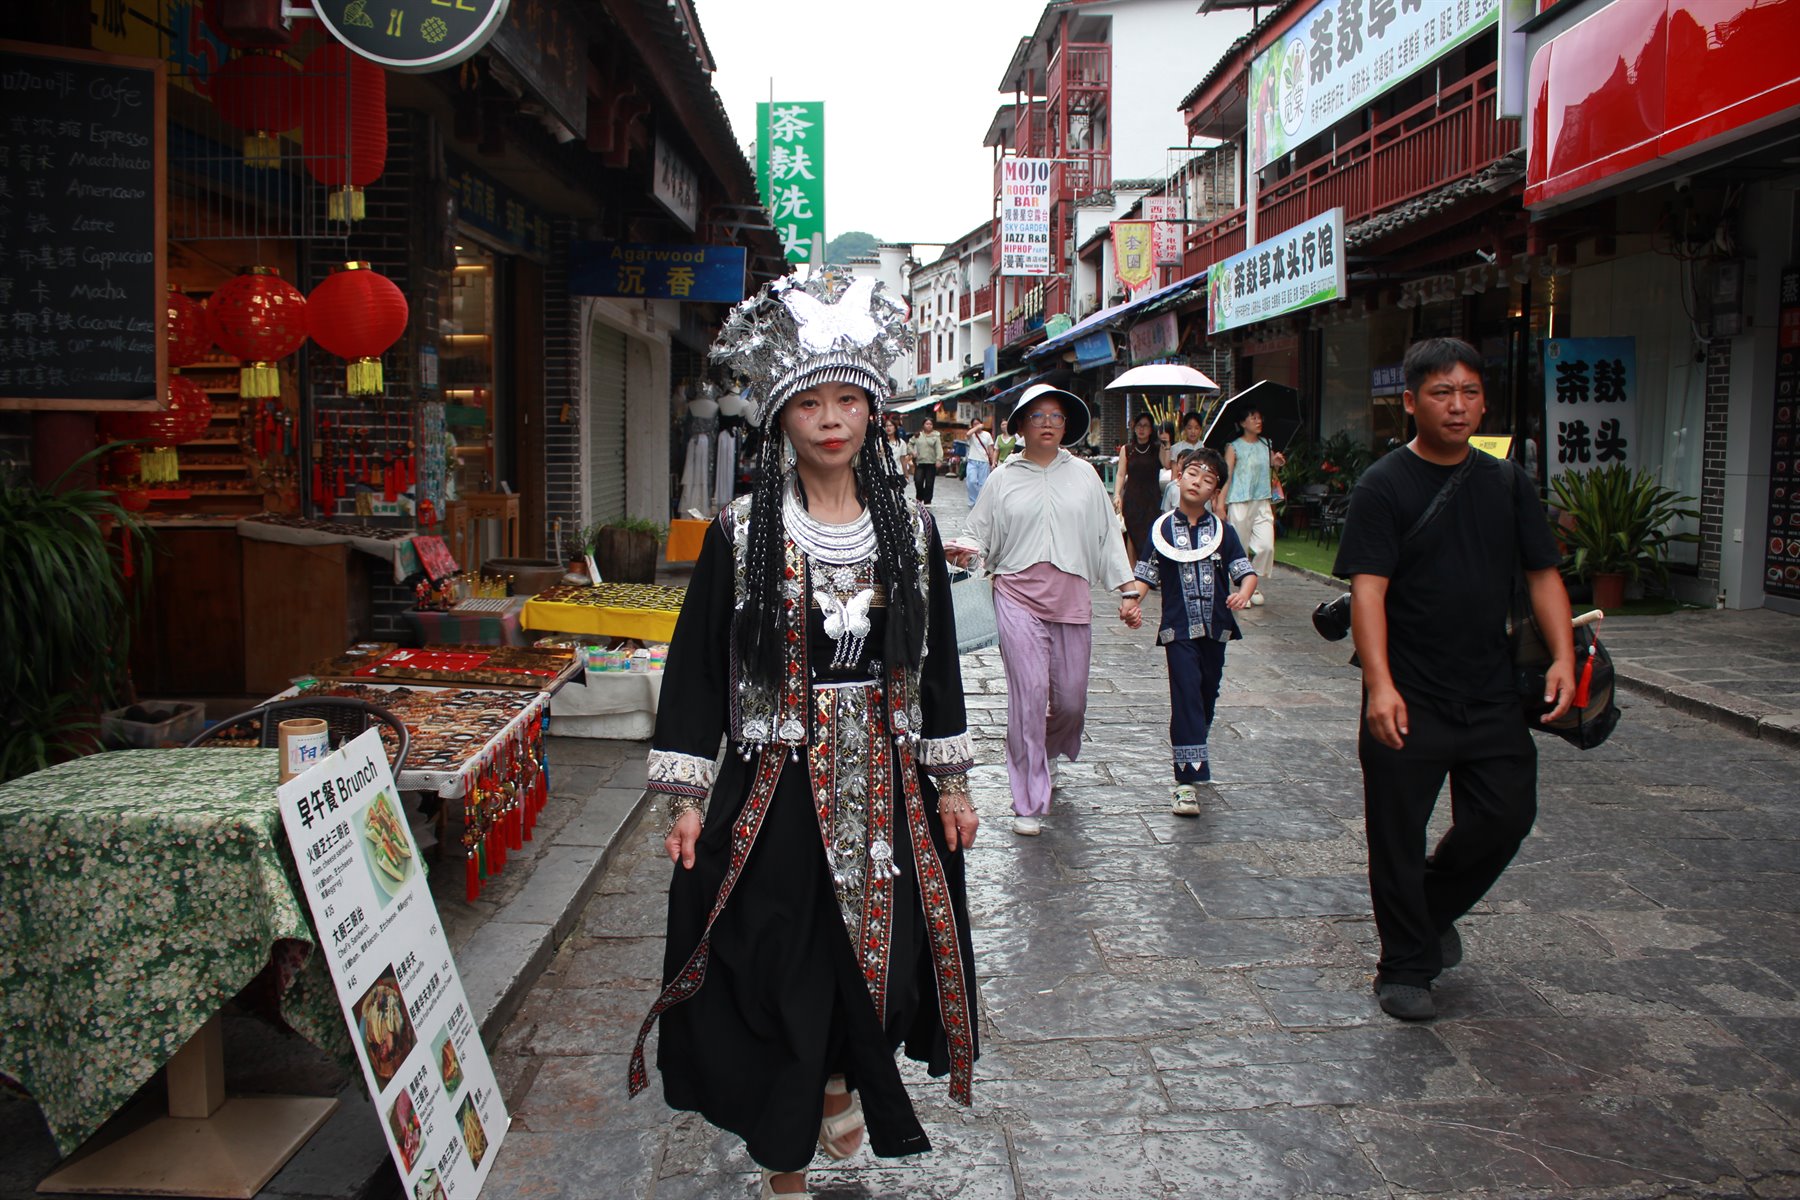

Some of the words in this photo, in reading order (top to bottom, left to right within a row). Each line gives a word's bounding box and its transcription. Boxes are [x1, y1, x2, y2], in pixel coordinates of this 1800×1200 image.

[1310, 0, 1421, 86] 茶麸草
[0, 114, 82, 138] 式浓缩
[90, 122, 148, 149] Espresso
[69, 152, 150, 170] Macchiato
[1005, 161, 1048, 183] MOJO
[66, 177, 145, 198] Americano
[1007, 185, 1047, 195] ROOFTOP
[1014, 197, 1039, 207] BAR
[72, 214, 115, 233] Latte
[1005, 223, 1019, 231] SKY
[1020, 223, 1048, 231] GARDEN
[1004, 244, 1032, 253] HIPHOP
[1005, 233, 1025, 243] JAZZ
[1028, 233, 1047, 243] R&B
[610, 245, 705, 263] Agarwood
[70, 278, 127, 300] Mocha
[617, 265, 695, 297] 沉香
[77, 315, 122, 330] Coconut
[1556, 359, 1627, 404] 茶麸
[1557, 419, 1627, 463] 洗头
[296, 779, 339, 829] 早午餐
[337, 756, 378, 802] Brunch
[322, 853, 336, 868] cheese
[335, 837, 353, 857] sandwich
[337, 941, 351, 959] Chef's
[350, 923, 369, 945] Sandwich
[414, 1085, 430, 1111] 三明治
